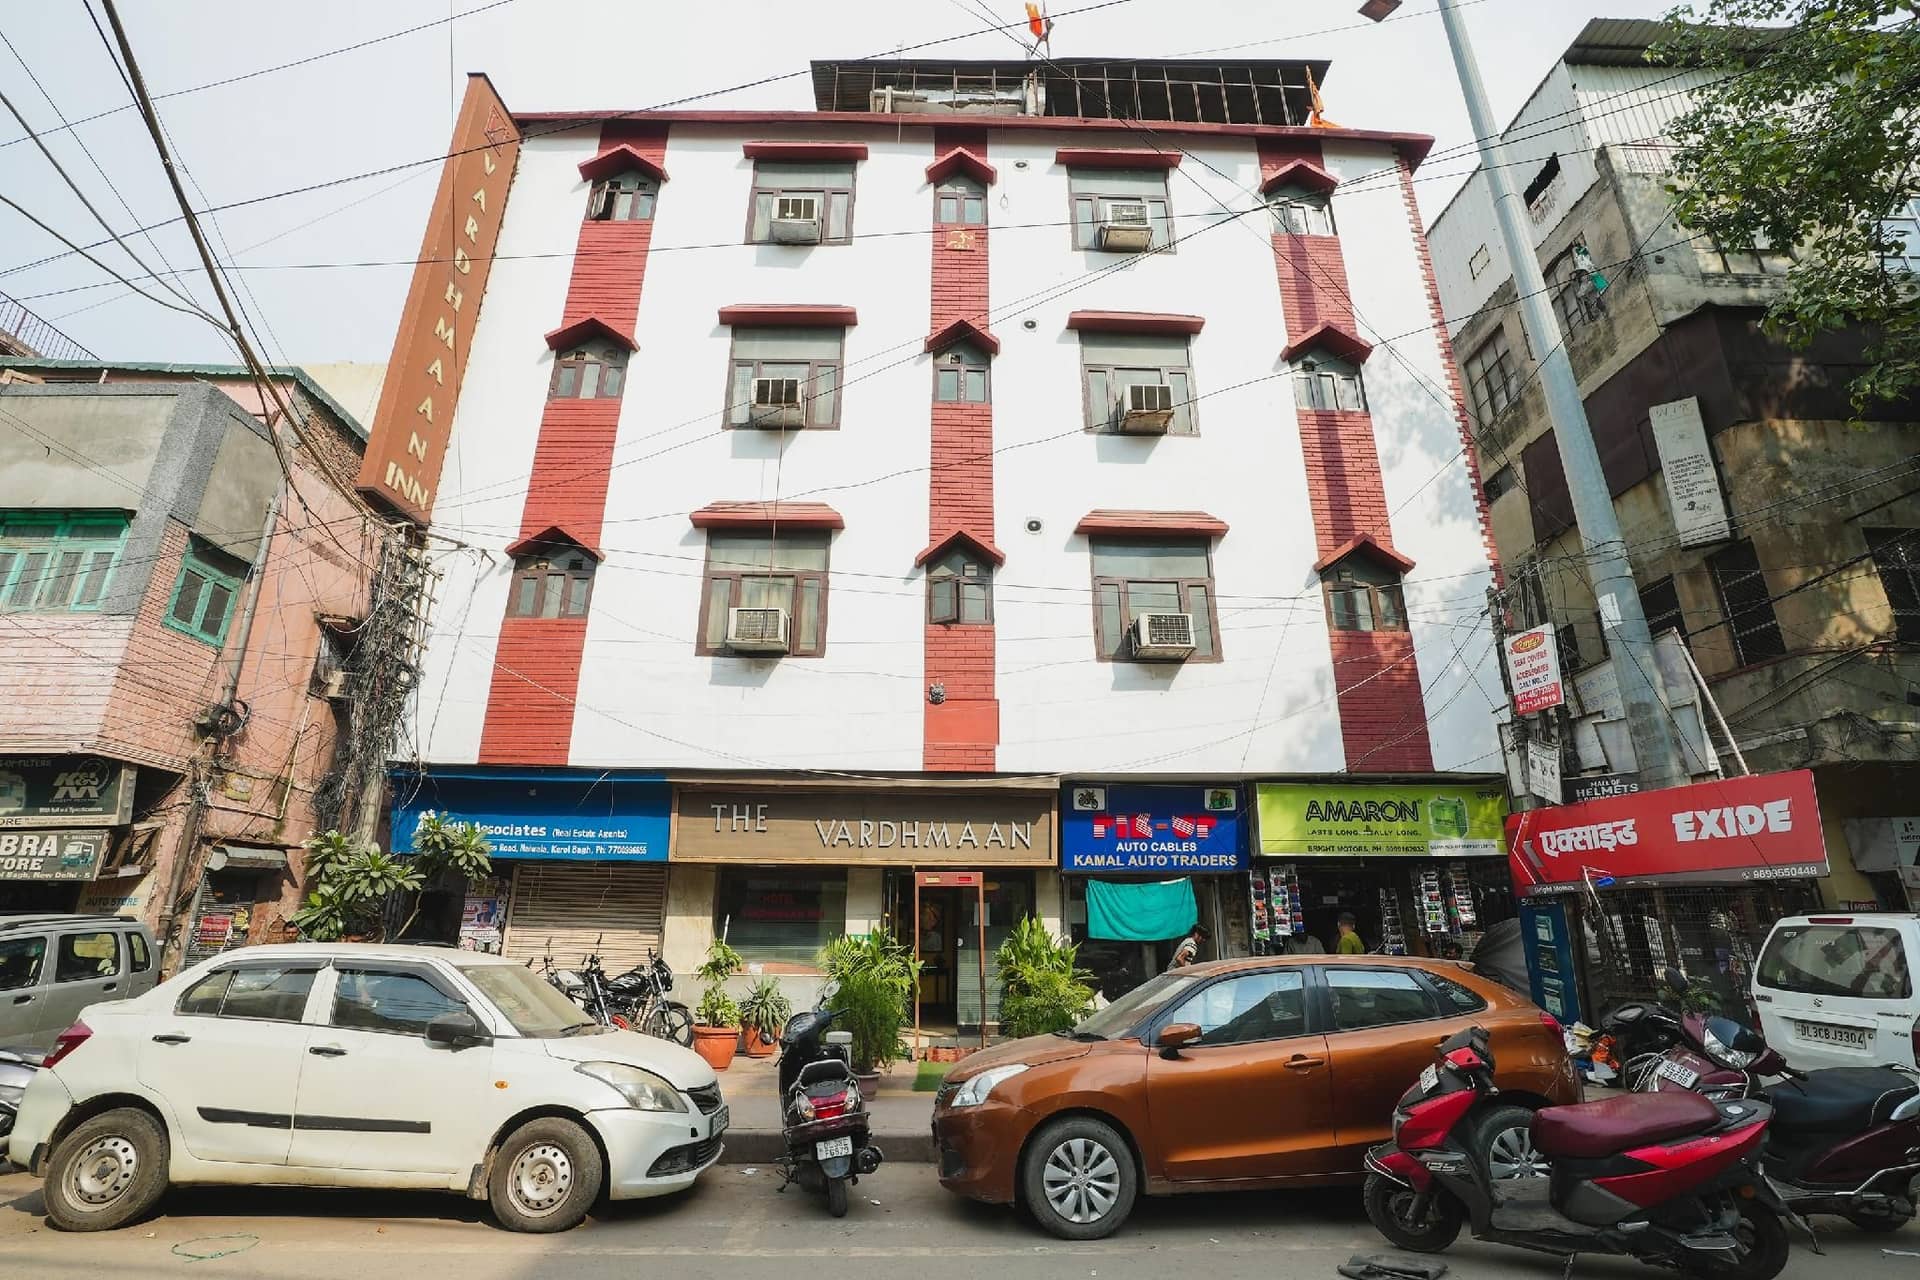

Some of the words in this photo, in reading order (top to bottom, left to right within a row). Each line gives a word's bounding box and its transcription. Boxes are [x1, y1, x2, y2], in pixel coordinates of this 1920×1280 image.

[407, 151, 496, 464] VARDHMAAN
[384, 459, 430, 512] INN
[1575, 783, 1640, 798] HELMETS
[711, 804, 769, 833] THE
[814, 819, 1032, 849] VARDHMAAN
[1305, 800, 1419, 822] AMARON
[1672, 798, 1792, 842] EXIDE
[1116, 841, 1148, 852] AUTO
[1150, 841, 1197, 852] CABLES
[1539, 818, 1638, 858] एक्साइड
[1073, 854, 1125, 867] KAMAL
[1127, 854, 1168, 867] AUTO
[1170, 854, 1238, 867] TRADERS
[110, 897, 139, 906] STORE
